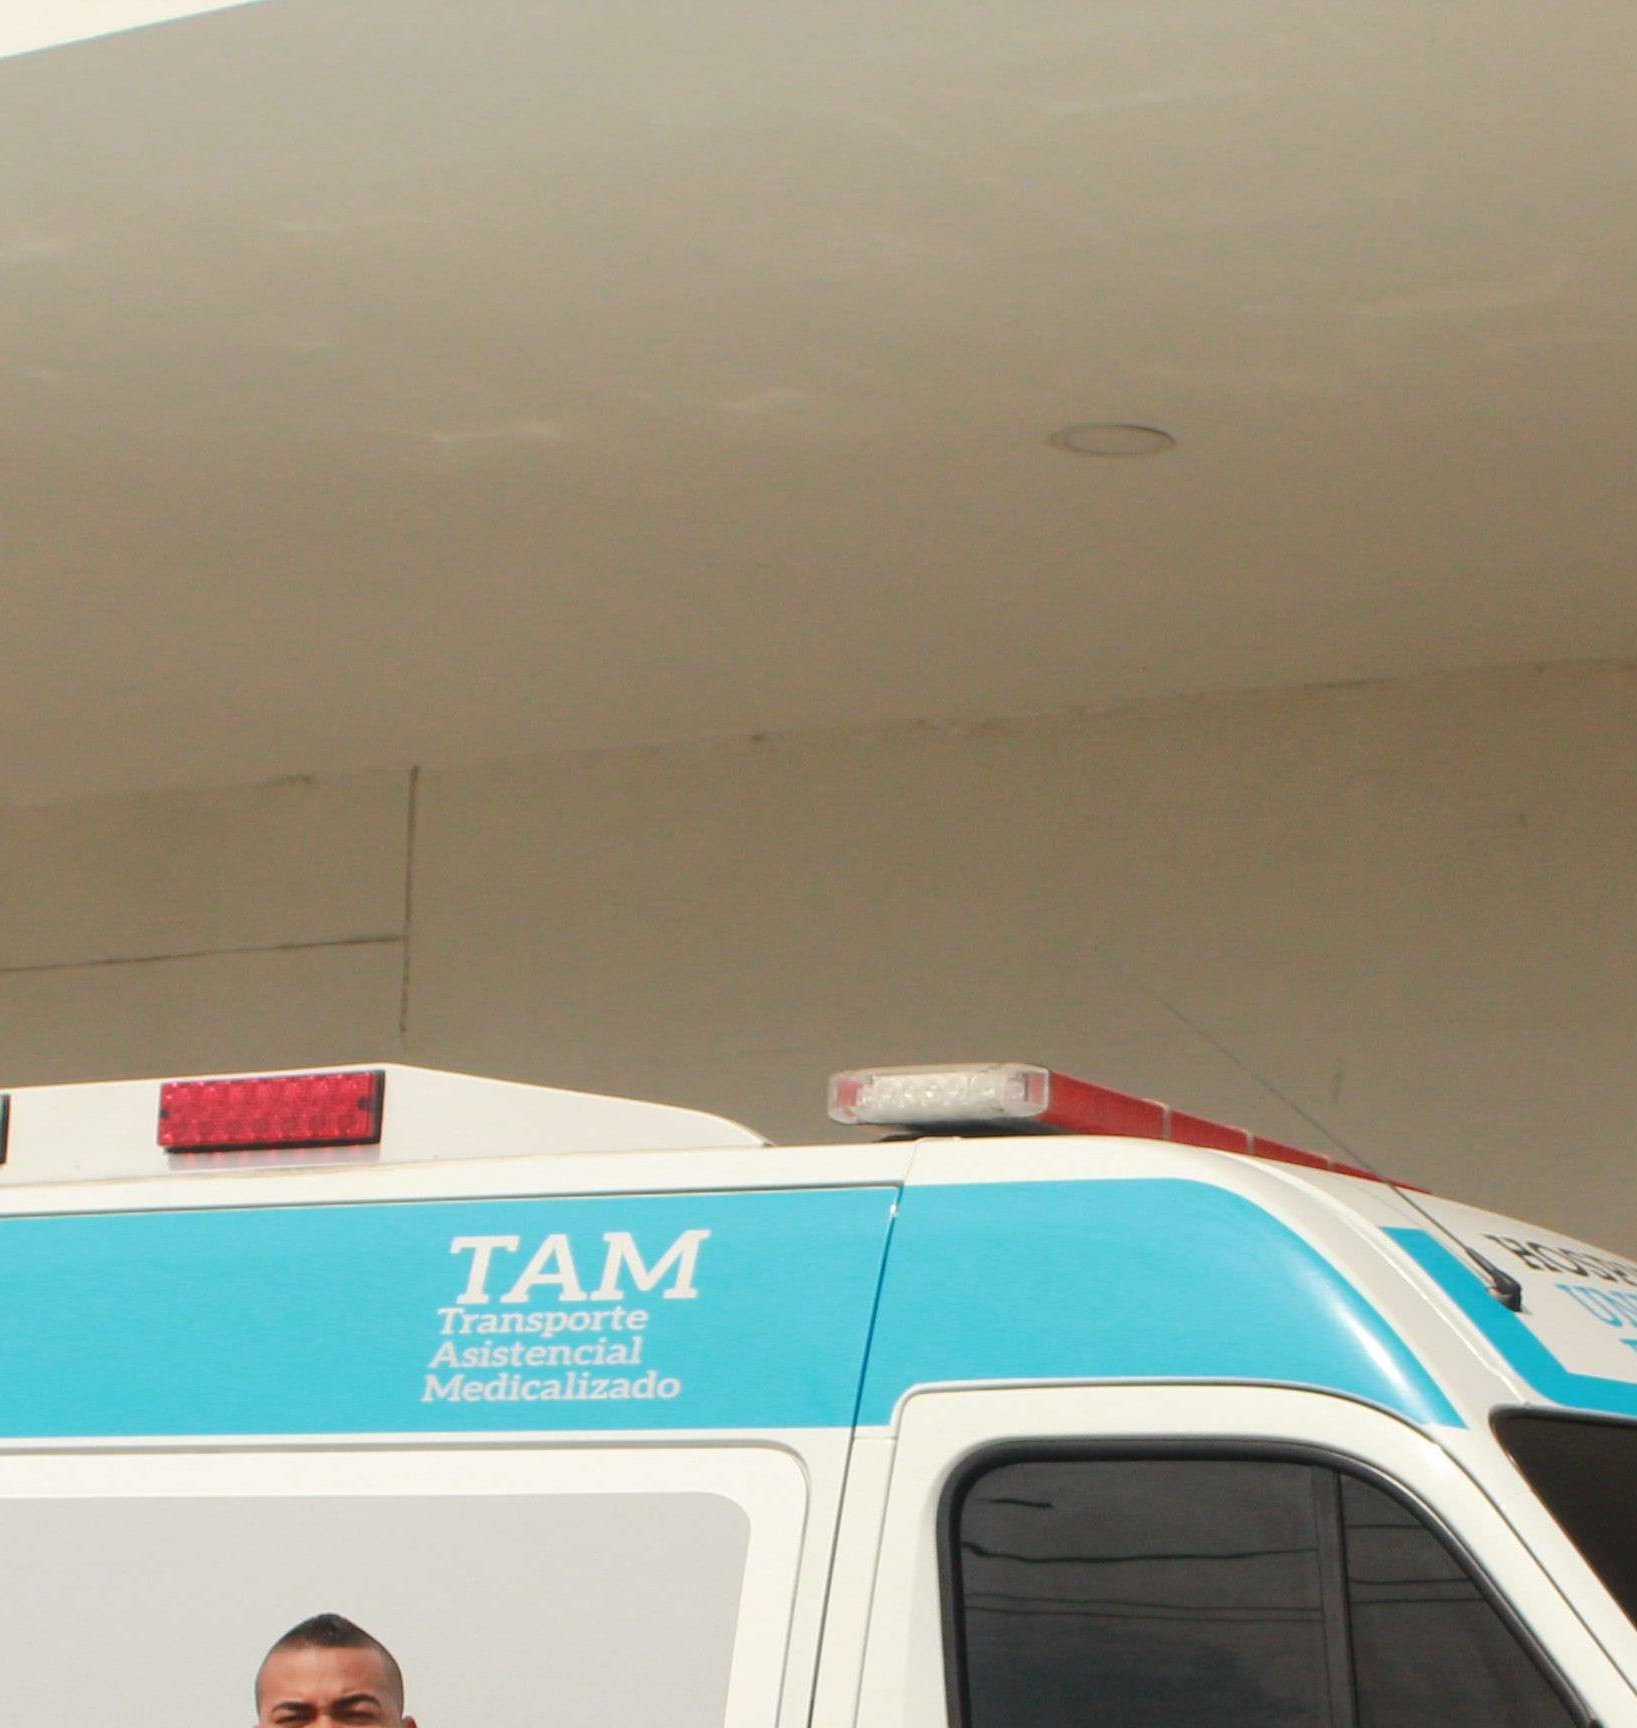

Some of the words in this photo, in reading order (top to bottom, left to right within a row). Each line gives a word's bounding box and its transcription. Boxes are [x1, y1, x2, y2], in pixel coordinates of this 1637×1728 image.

[449, 1229, 712, 1304] TAM
[437, 1305, 649, 1337] Transporte
[428, 1336, 643, 1369] Asistencial
[421, 1370, 682, 1402] Medicalizado
